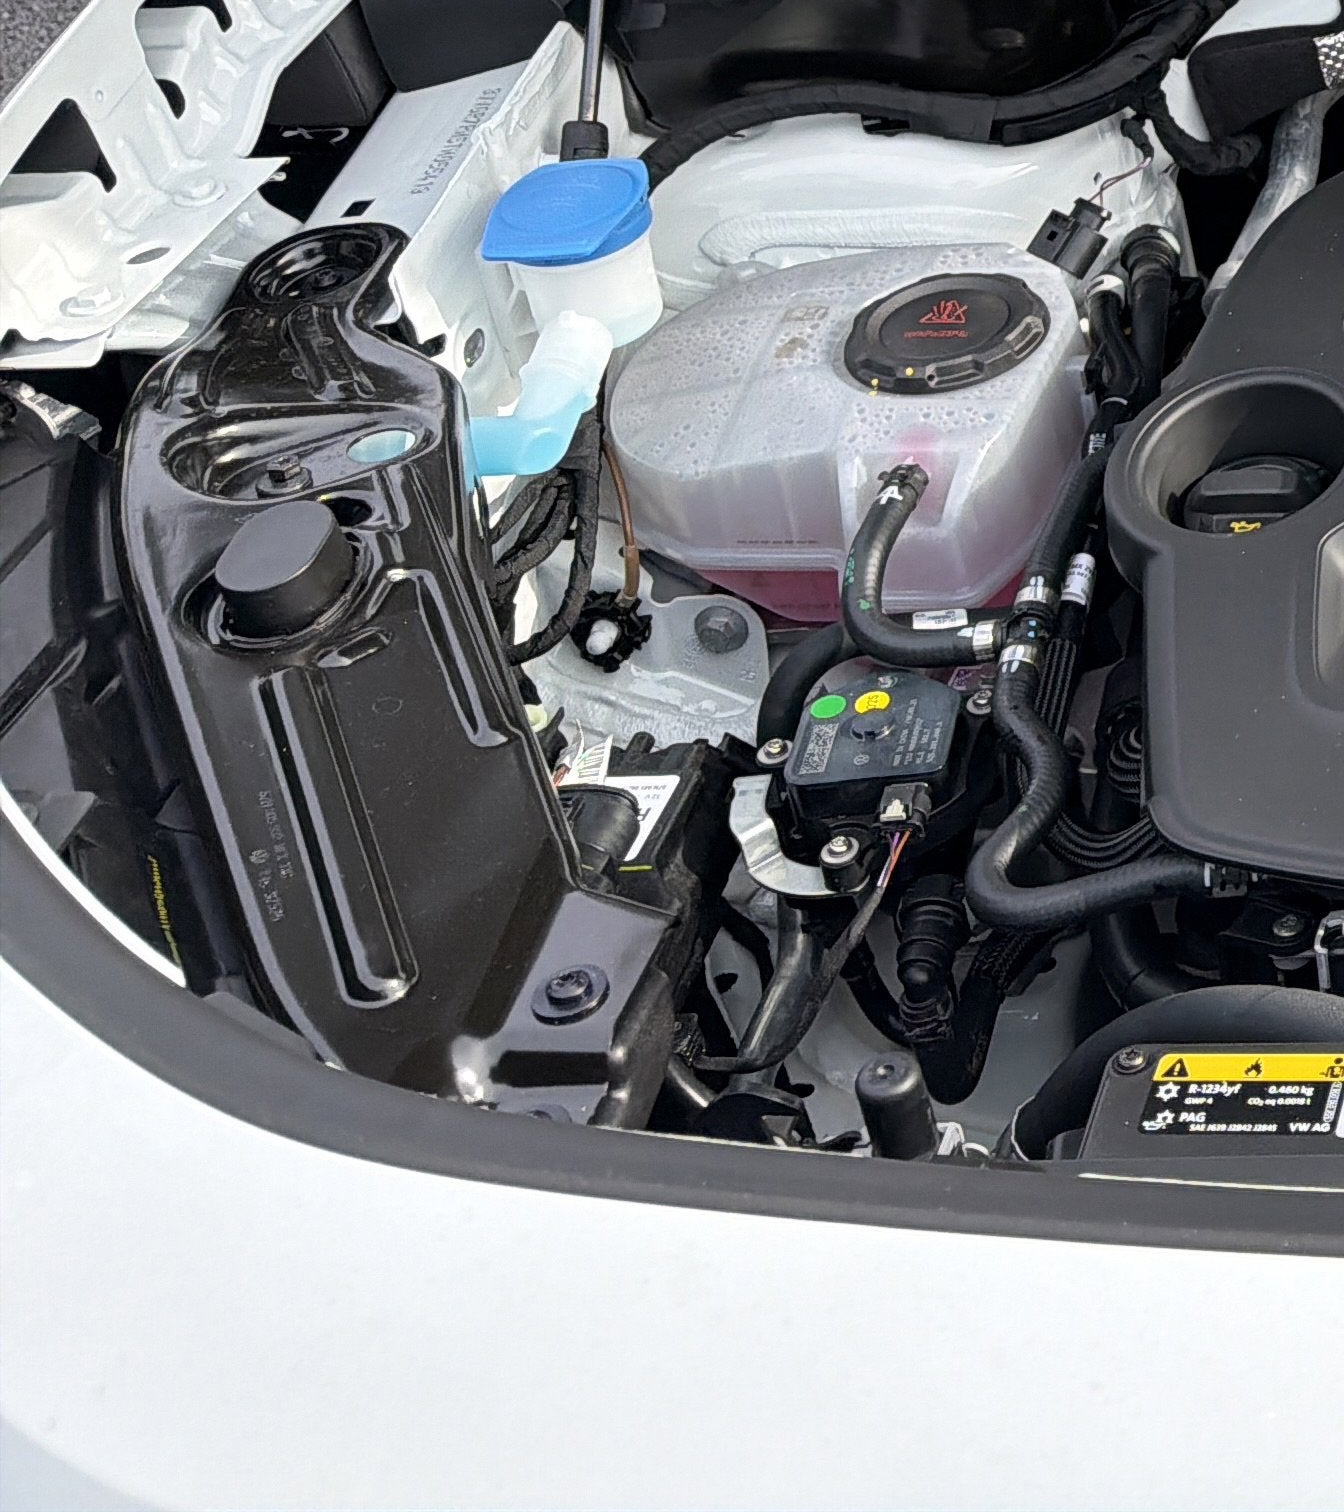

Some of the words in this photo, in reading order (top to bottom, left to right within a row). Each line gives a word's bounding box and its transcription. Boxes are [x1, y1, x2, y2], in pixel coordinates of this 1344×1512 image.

[1187, 1083, 1242, 1097] R-1234yf
[1301, 1085, 1315, 1096] kg
[1179, 1112, 1206, 1123] PAG
[1289, 1123, 1311, 1132] VW
[1312, 1122, 1331, 1132] AG
